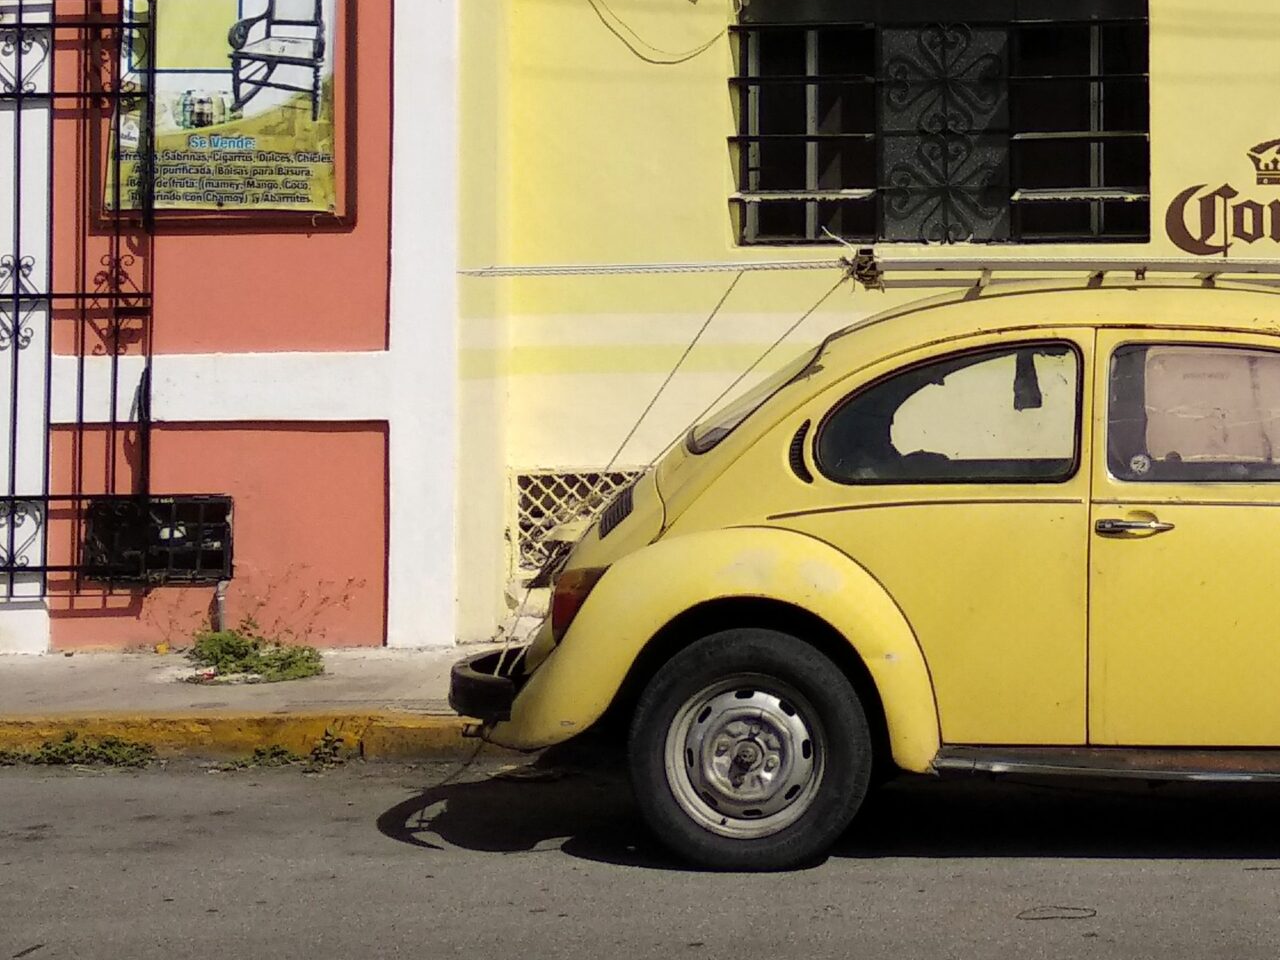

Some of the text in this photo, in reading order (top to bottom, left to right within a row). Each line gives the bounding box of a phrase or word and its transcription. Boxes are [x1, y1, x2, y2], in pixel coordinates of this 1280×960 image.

[191, 136, 256, 149] Se Vende:
[252, 167, 273, 177] para
